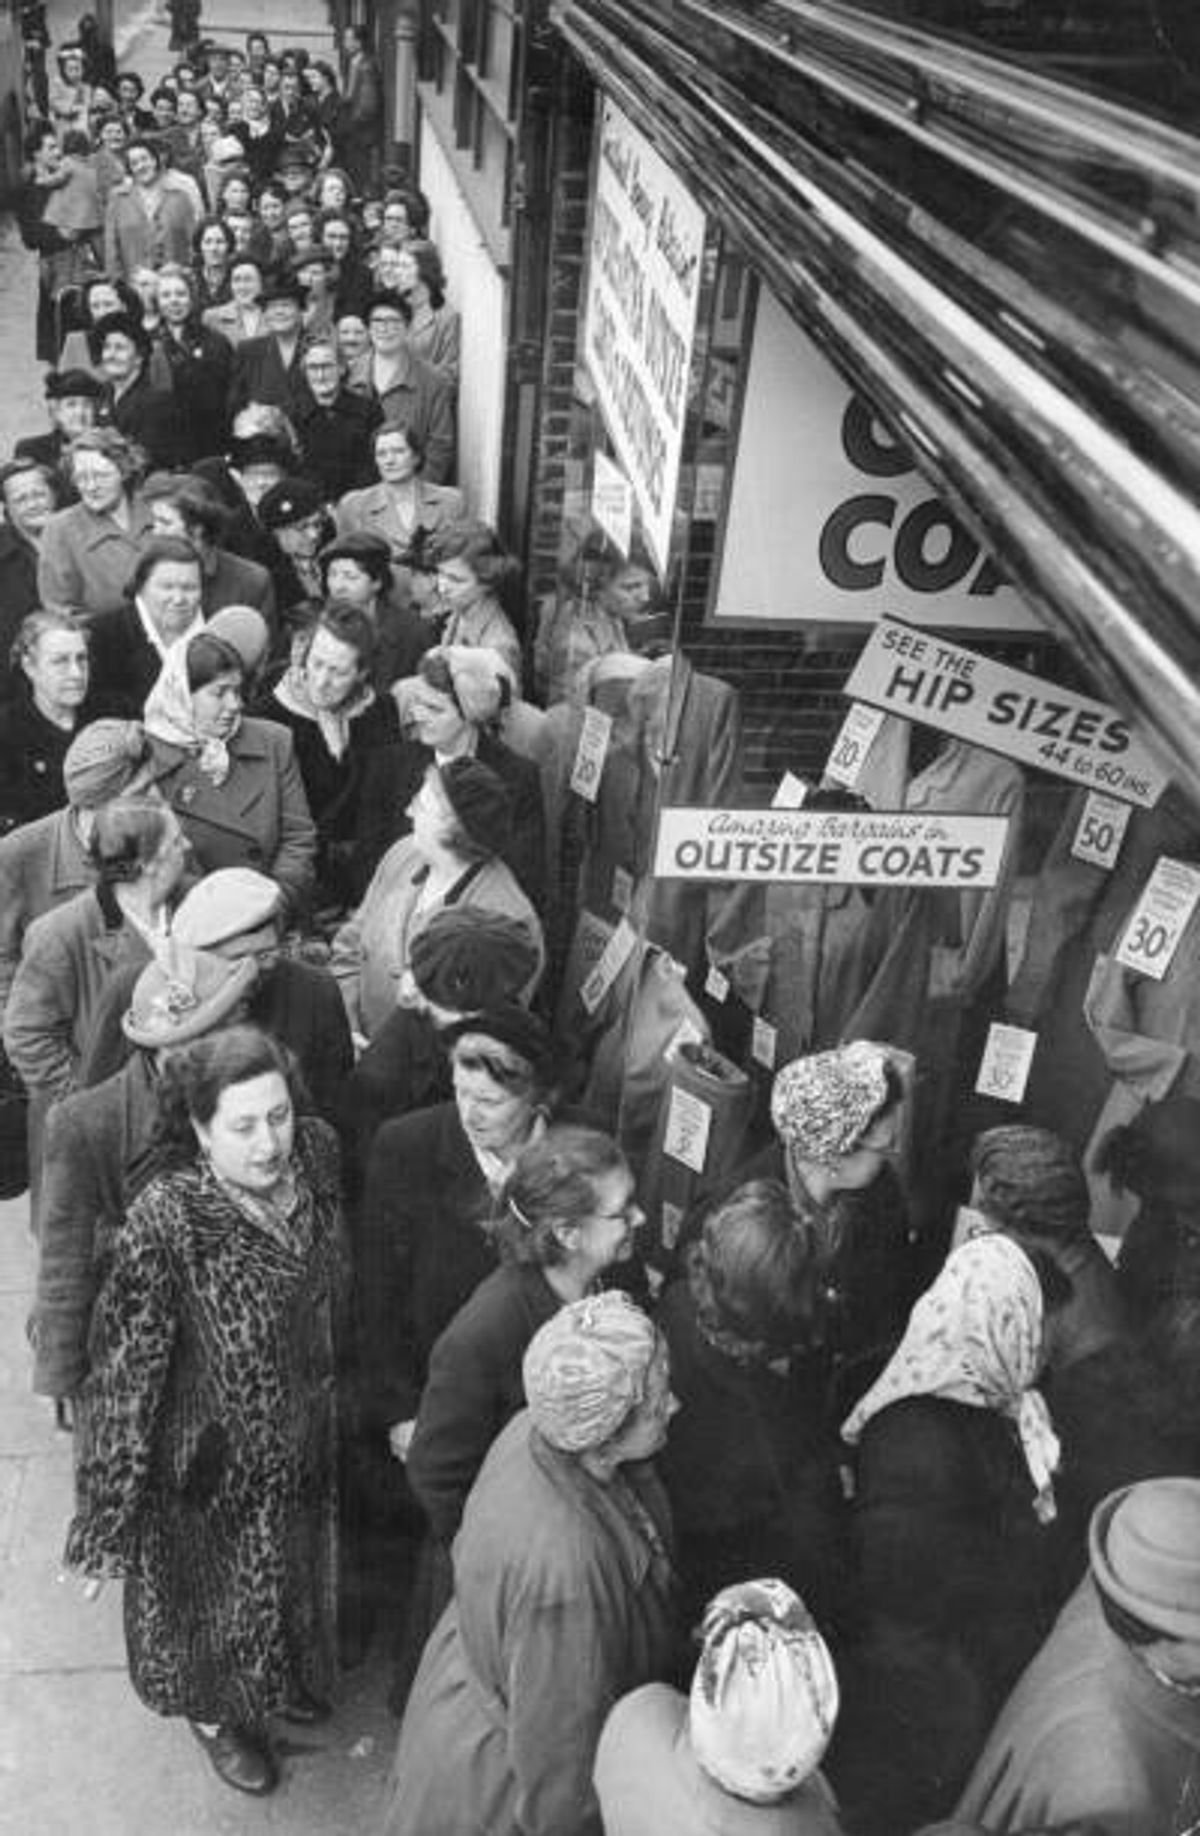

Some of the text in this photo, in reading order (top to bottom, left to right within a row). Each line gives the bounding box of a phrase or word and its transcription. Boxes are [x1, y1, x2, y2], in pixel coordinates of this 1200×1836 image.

[881, 629, 977, 679] SEE THE
[885, 665, 1130, 754] HIP SIZES
[1038, 741, 1071, 764] 44
[1095, 761, 1126, 787] 60
[1079, 817, 1114, 852] 50
[674, 839, 985, 879] OUTSIZE COATS
